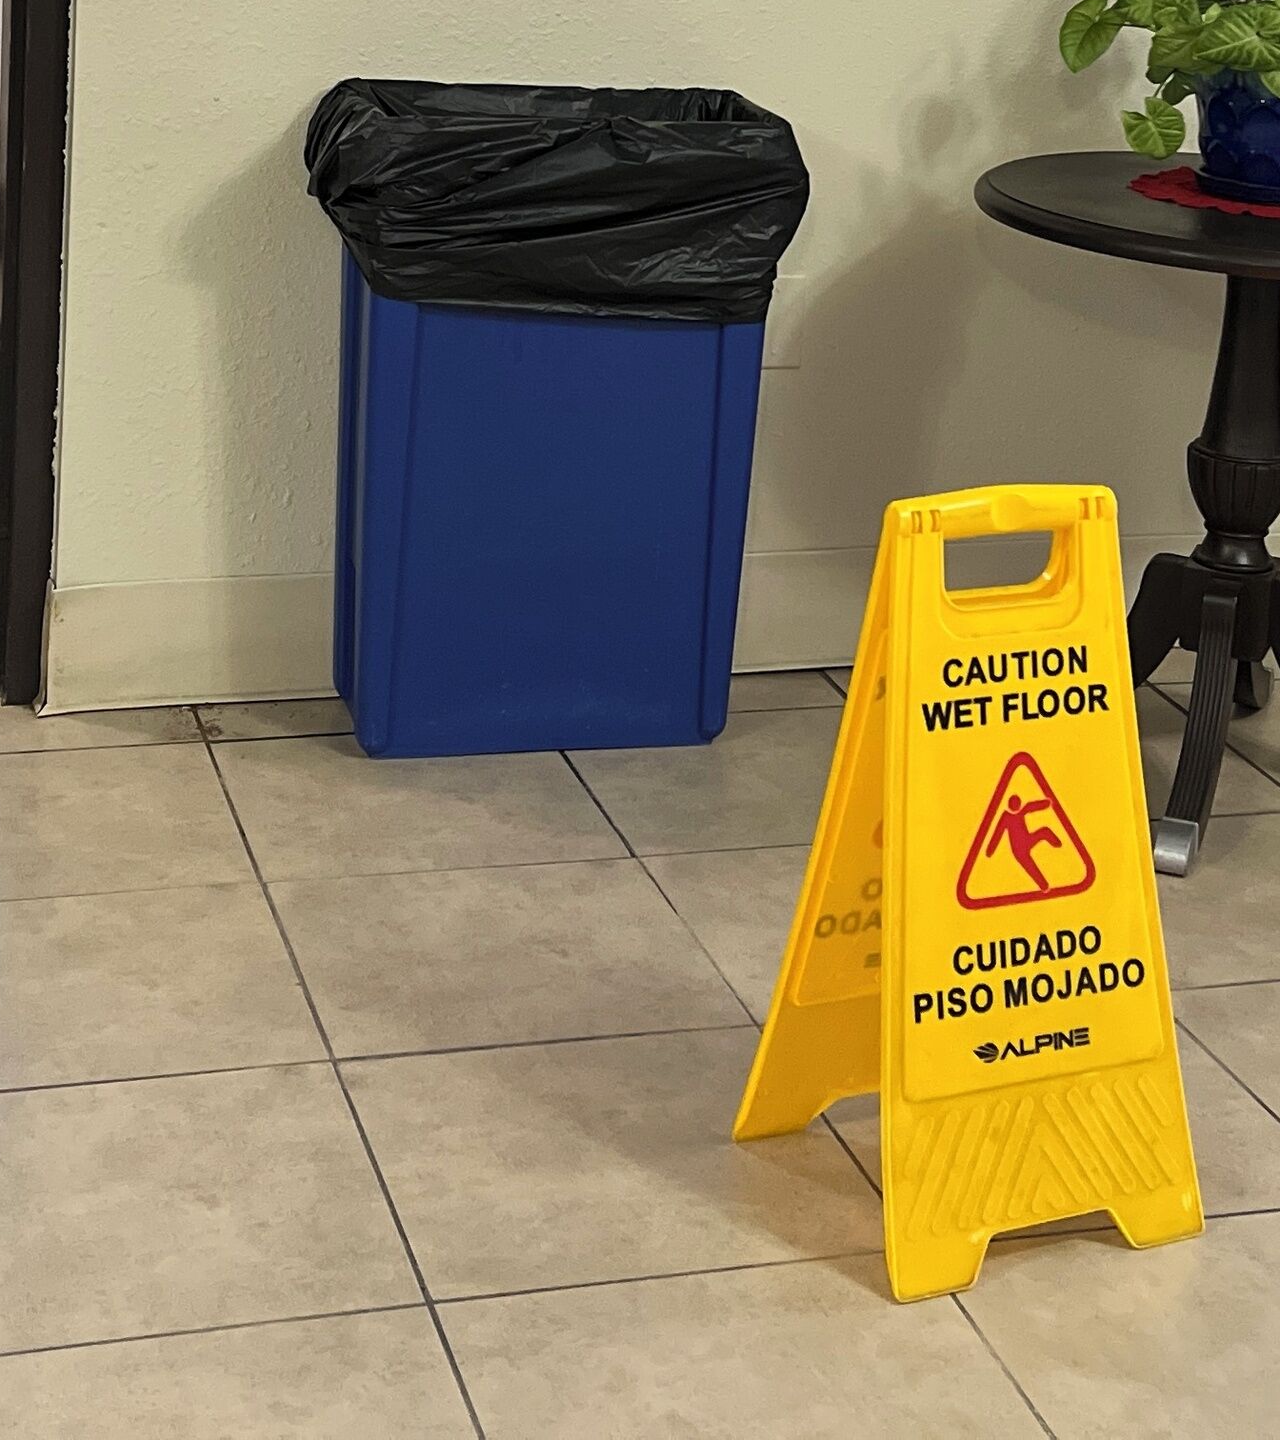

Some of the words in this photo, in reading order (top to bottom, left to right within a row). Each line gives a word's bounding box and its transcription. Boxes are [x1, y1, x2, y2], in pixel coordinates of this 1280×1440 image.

[942, 645, 1088, 688] CAUTION
[921, 696, 993, 732] WET
[1002, 683, 1110, 723] FLOOR
[952, 925, 1102, 976] CUIDADO
[913, 983, 994, 1024] PISO
[1004, 958, 1145, 1009] MOJADO
[1000, 1027, 1091, 1061] ALPINE
